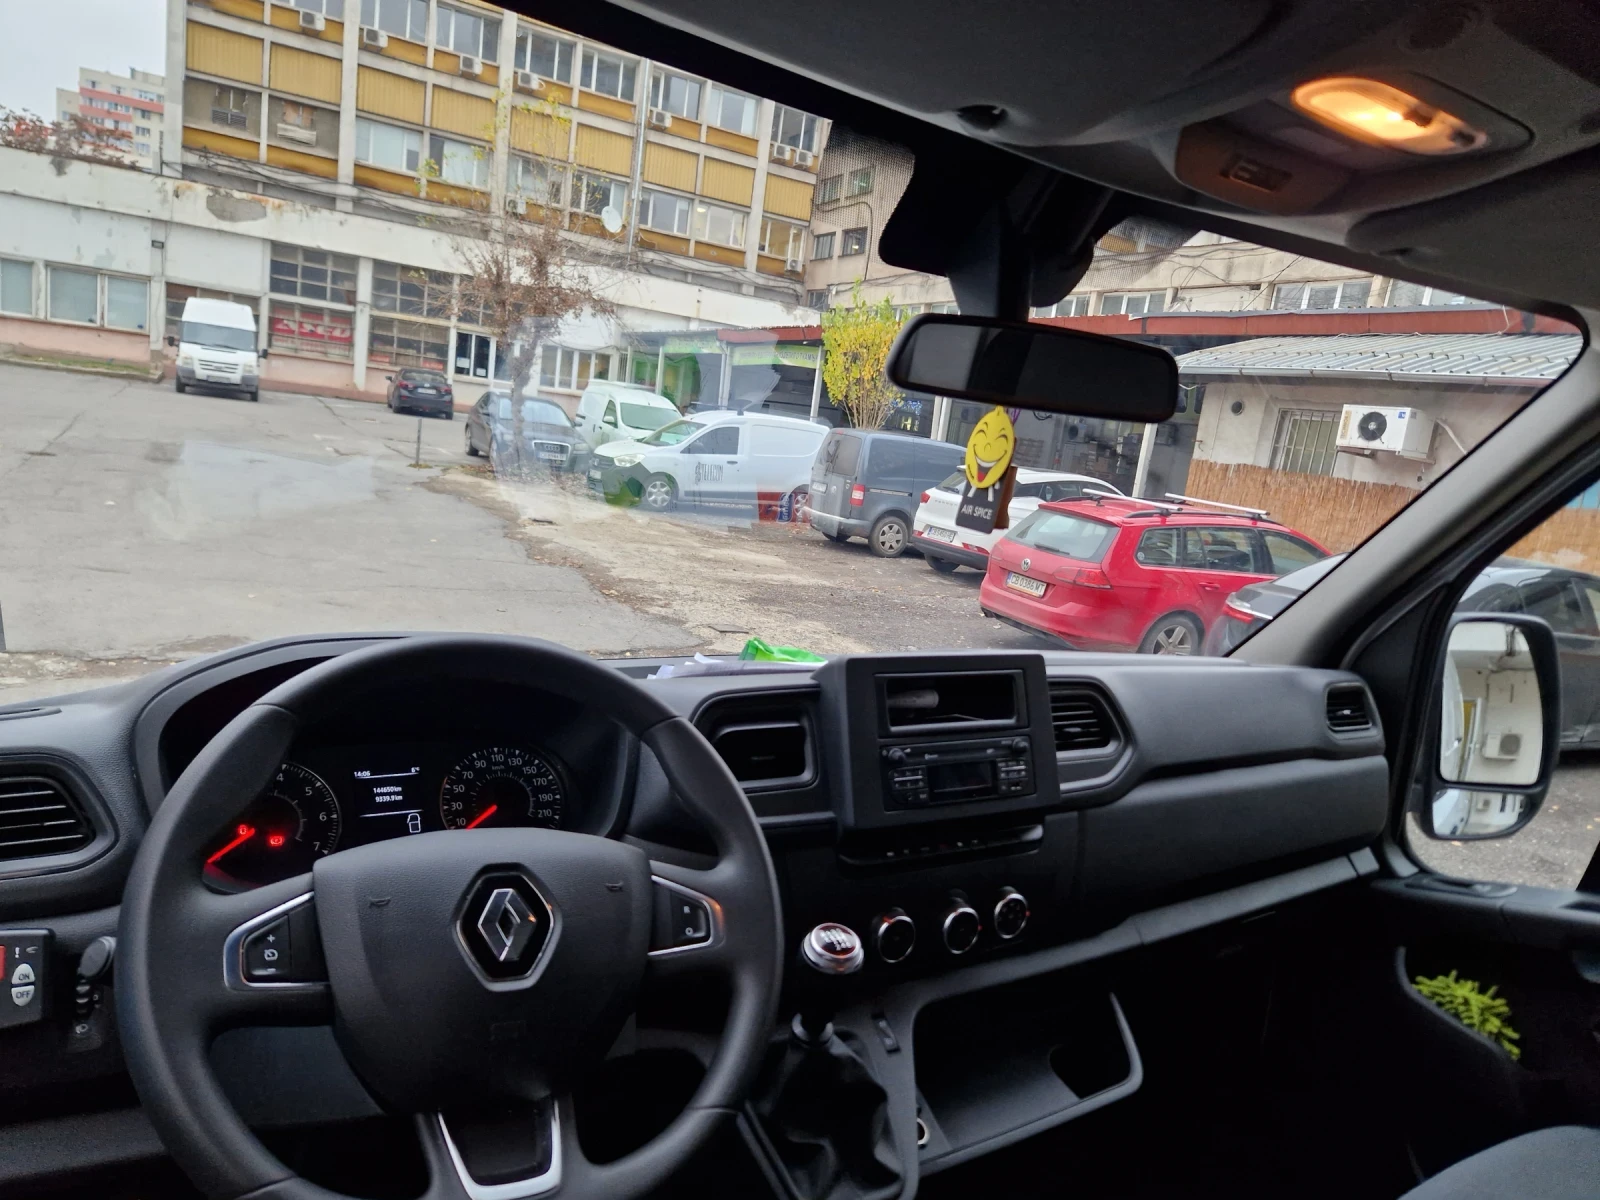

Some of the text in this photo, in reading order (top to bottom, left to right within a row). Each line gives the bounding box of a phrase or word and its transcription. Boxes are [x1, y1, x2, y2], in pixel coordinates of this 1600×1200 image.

[961, 504, 993, 520] AIR SPICE
[491, 754, 504, 762] 110
[508, 757, 522, 766] 130
[474, 760, 486, 768] 90
[522, 766, 537, 774] 150
[276, 773, 284, 782] 4
[462, 771, 473, 779] 70
[533, 777, 547, 786] 170
[305, 786, 313, 796] 5
[453, 784, 465, 793] 50
[538, 793, 553, 802] 190
[451, 802, 463, 811] 30
[319, 812, 327, 821] 6
[538, 809, 552, 818] 210
[456, 817, 466, 826] 10
[313, 842, 321, 851] 7
[18, 973, 30, 981] ON
[15, 991, 31, 999] OFF
